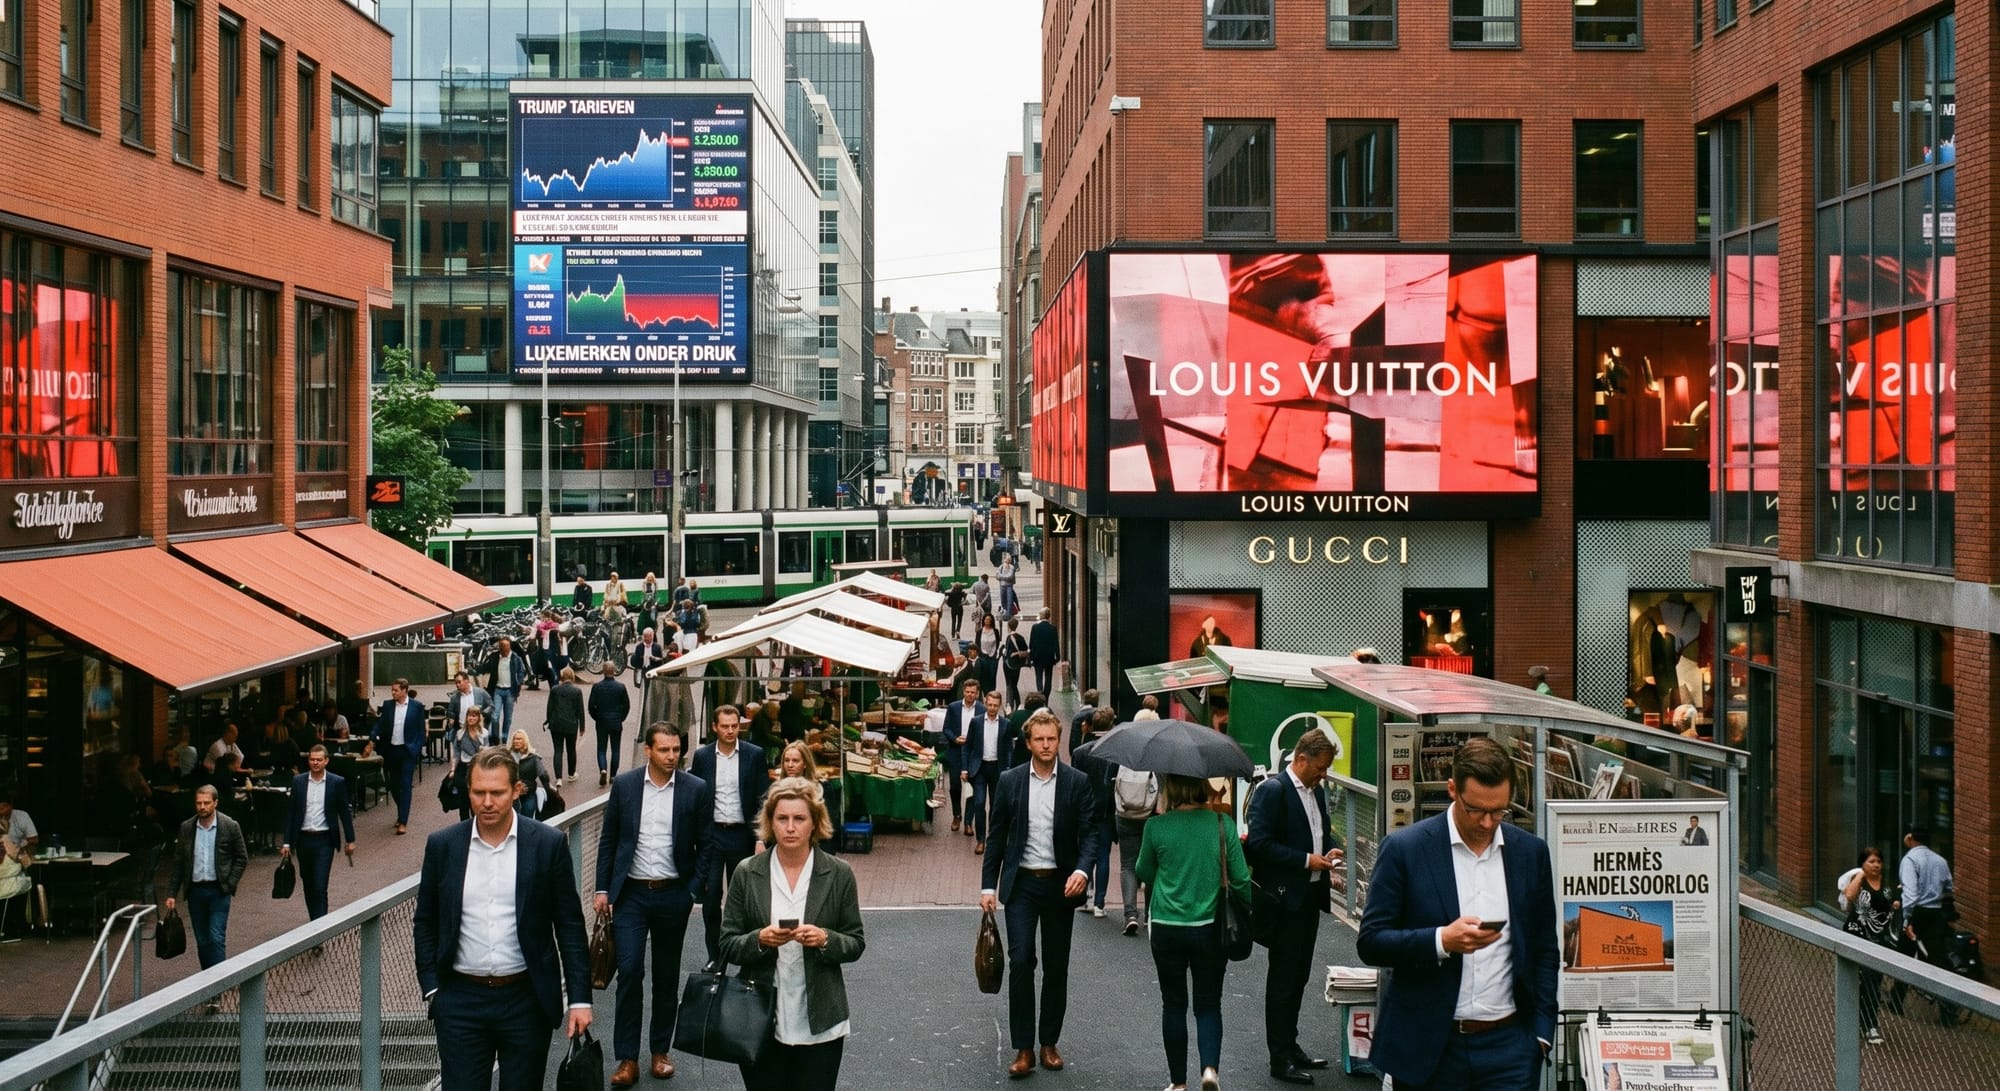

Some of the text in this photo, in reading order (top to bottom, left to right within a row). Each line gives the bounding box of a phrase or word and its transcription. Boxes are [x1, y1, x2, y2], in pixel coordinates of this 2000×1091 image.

[518, 100, 635, 114] TRUMP TARIEVEN
[525, 345, 736, 361] LUXEMERKEN ONDER DRUK
[1149, 362, 1497, 397] LOUIS VUITTON
[1241, 496, 1409, 513] LOUIS VUITTON
[1249, 536, 1408, 564] GUCCI
[1593, 846, 1662, 872] HERMÈS
[1563, 874, 1709, 896] HANDELSOORLOG
